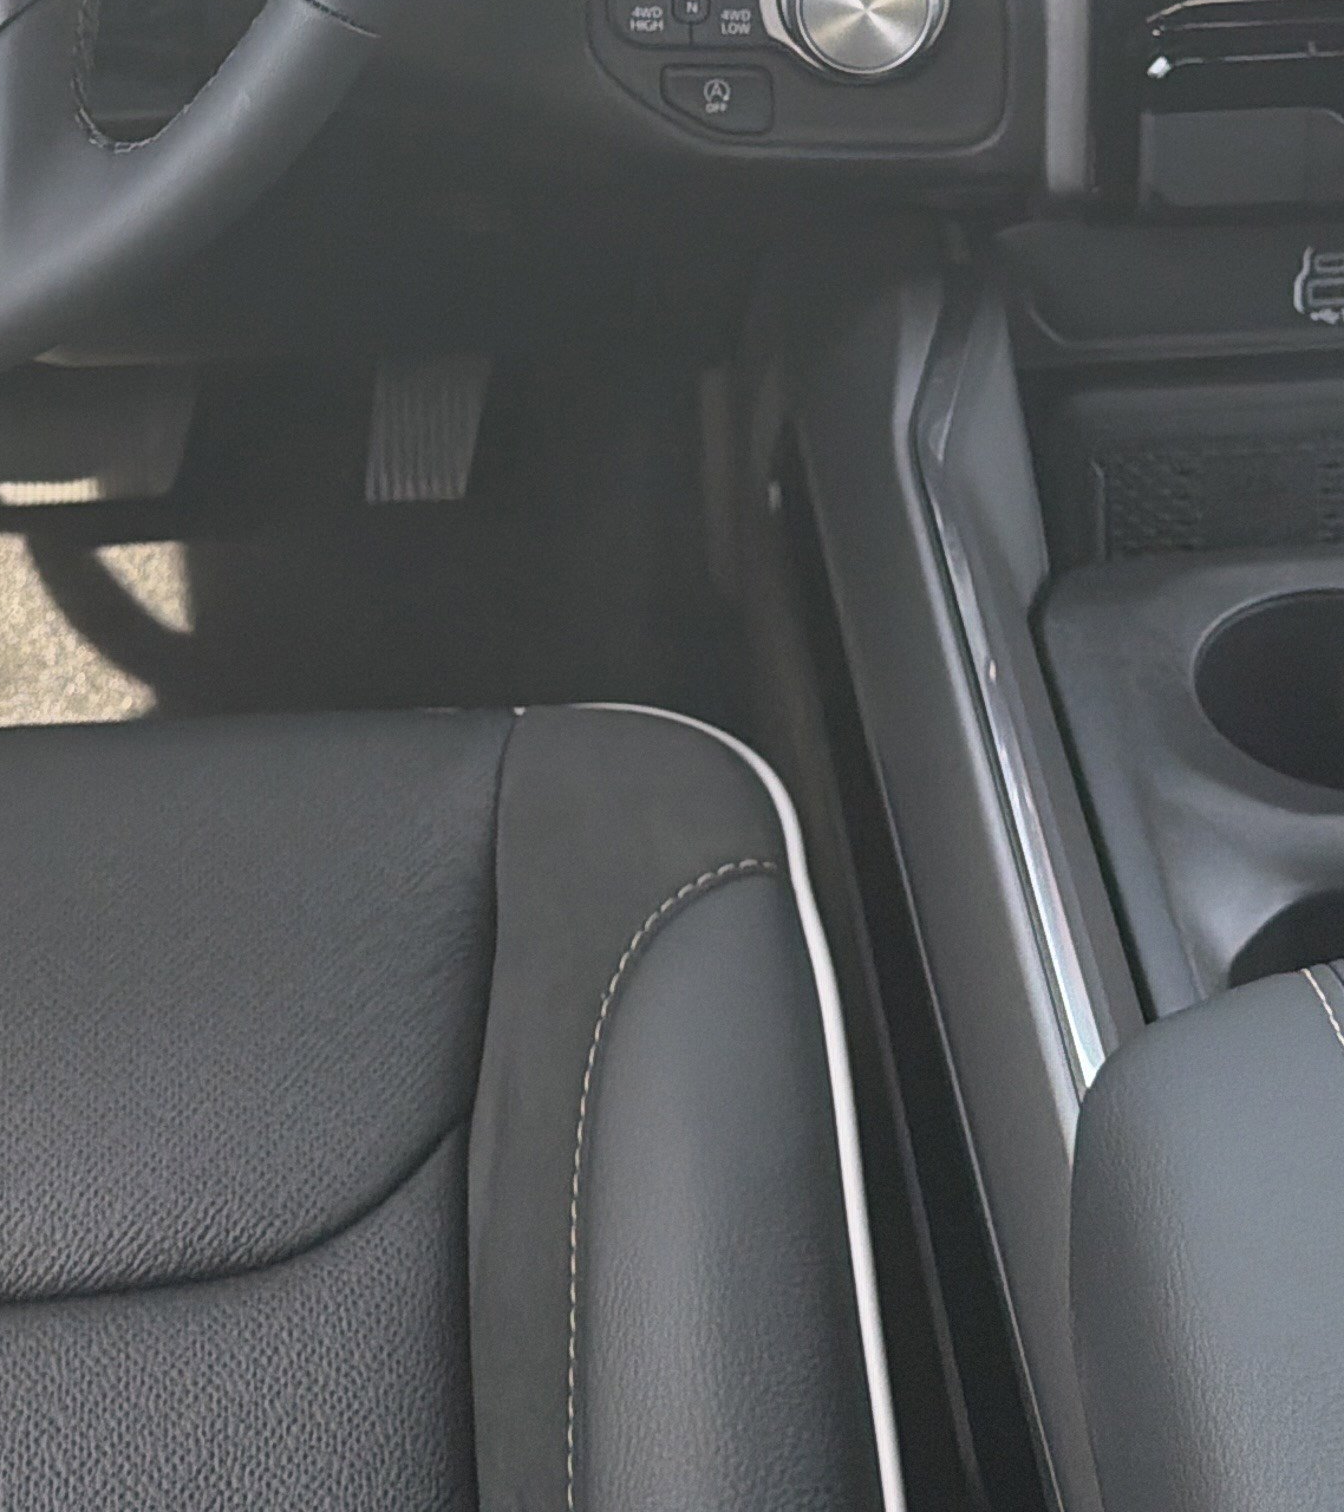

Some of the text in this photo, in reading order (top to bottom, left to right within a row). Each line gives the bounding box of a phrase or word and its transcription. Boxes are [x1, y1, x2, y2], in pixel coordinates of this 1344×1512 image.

[632, 5, 664, 18] 4WD
[686, 0, 698, 14] N
[721, 9, 751, 21] 4WD
[630, 19, 664, 32] HIGH
[720, 22, 751, 35] LOW
